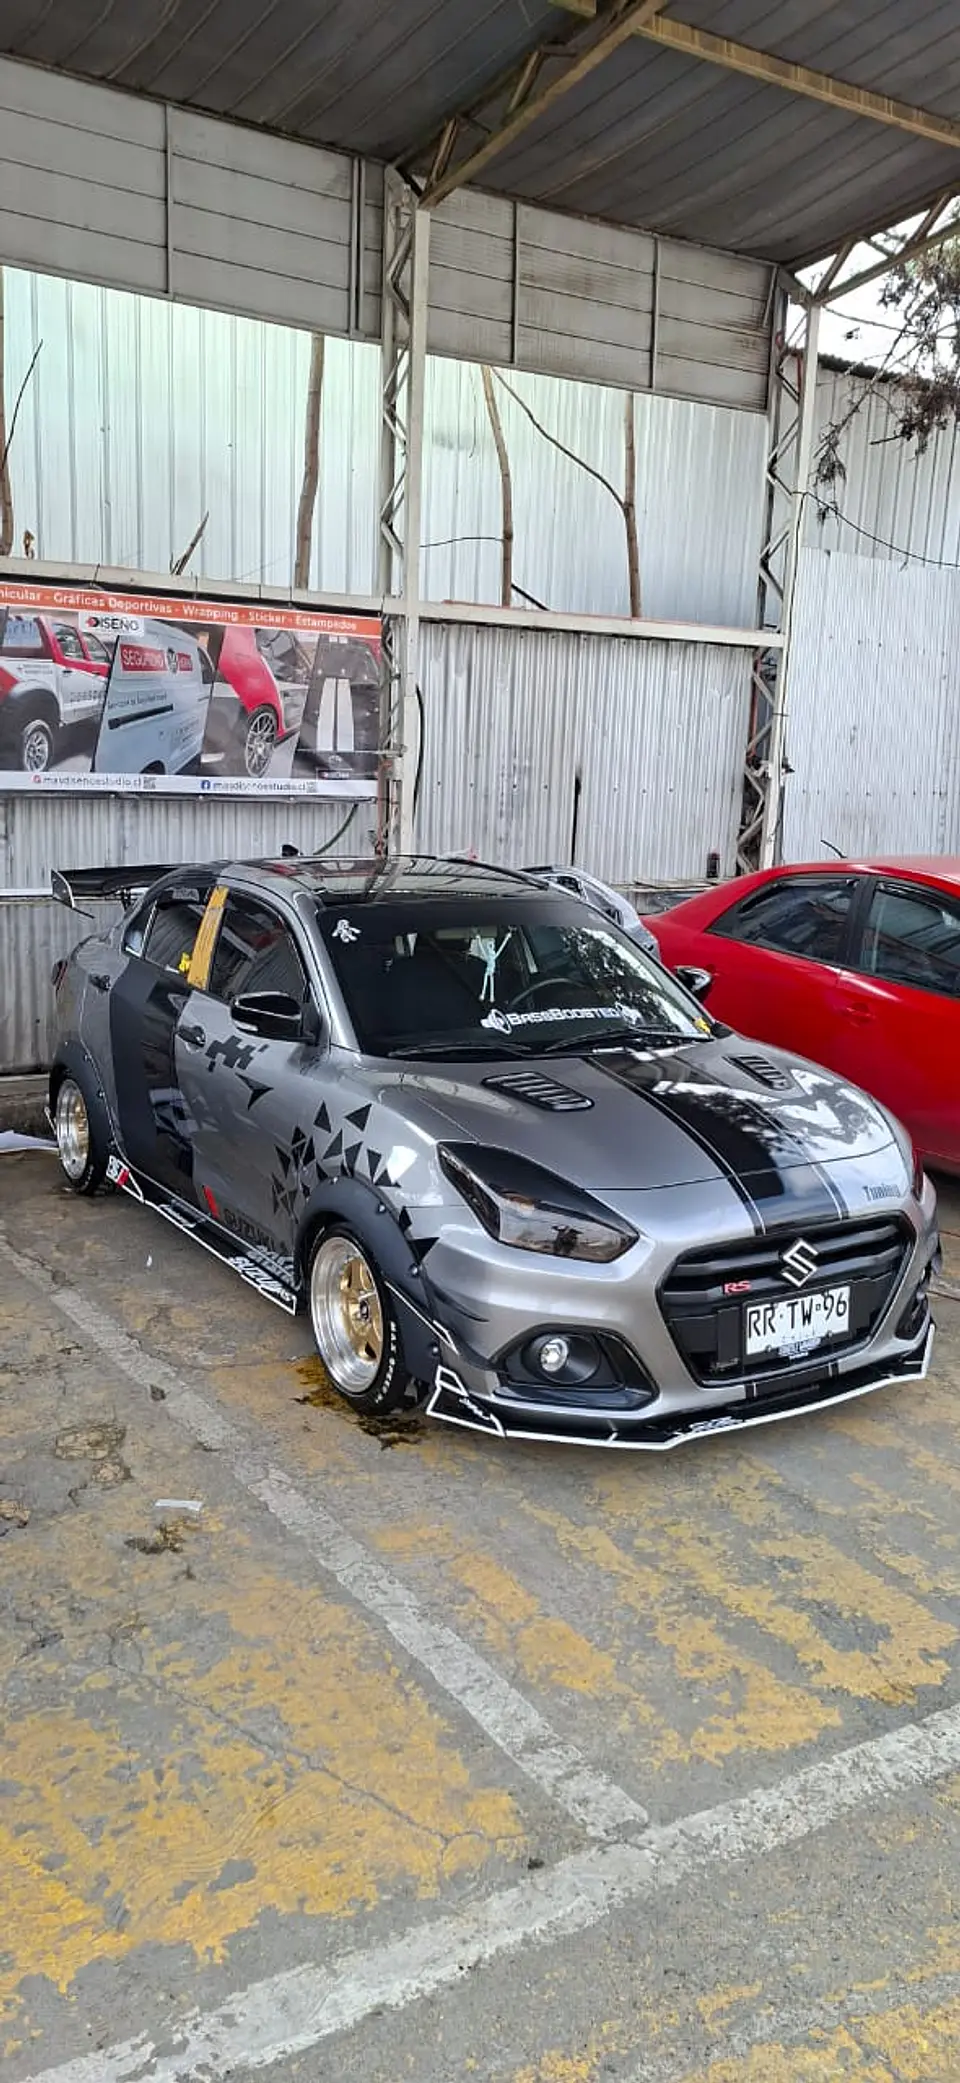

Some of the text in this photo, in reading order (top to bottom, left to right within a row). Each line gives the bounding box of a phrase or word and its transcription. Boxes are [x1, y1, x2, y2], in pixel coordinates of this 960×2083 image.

[108, 597, 172, 614] Deportivas
[182, 604, 239, 622] Wrapping
[248, 611, 285, 624] Sticker
[296, 613, 357, 630] Estampados
[724, 1281, 752, 1294] RS
